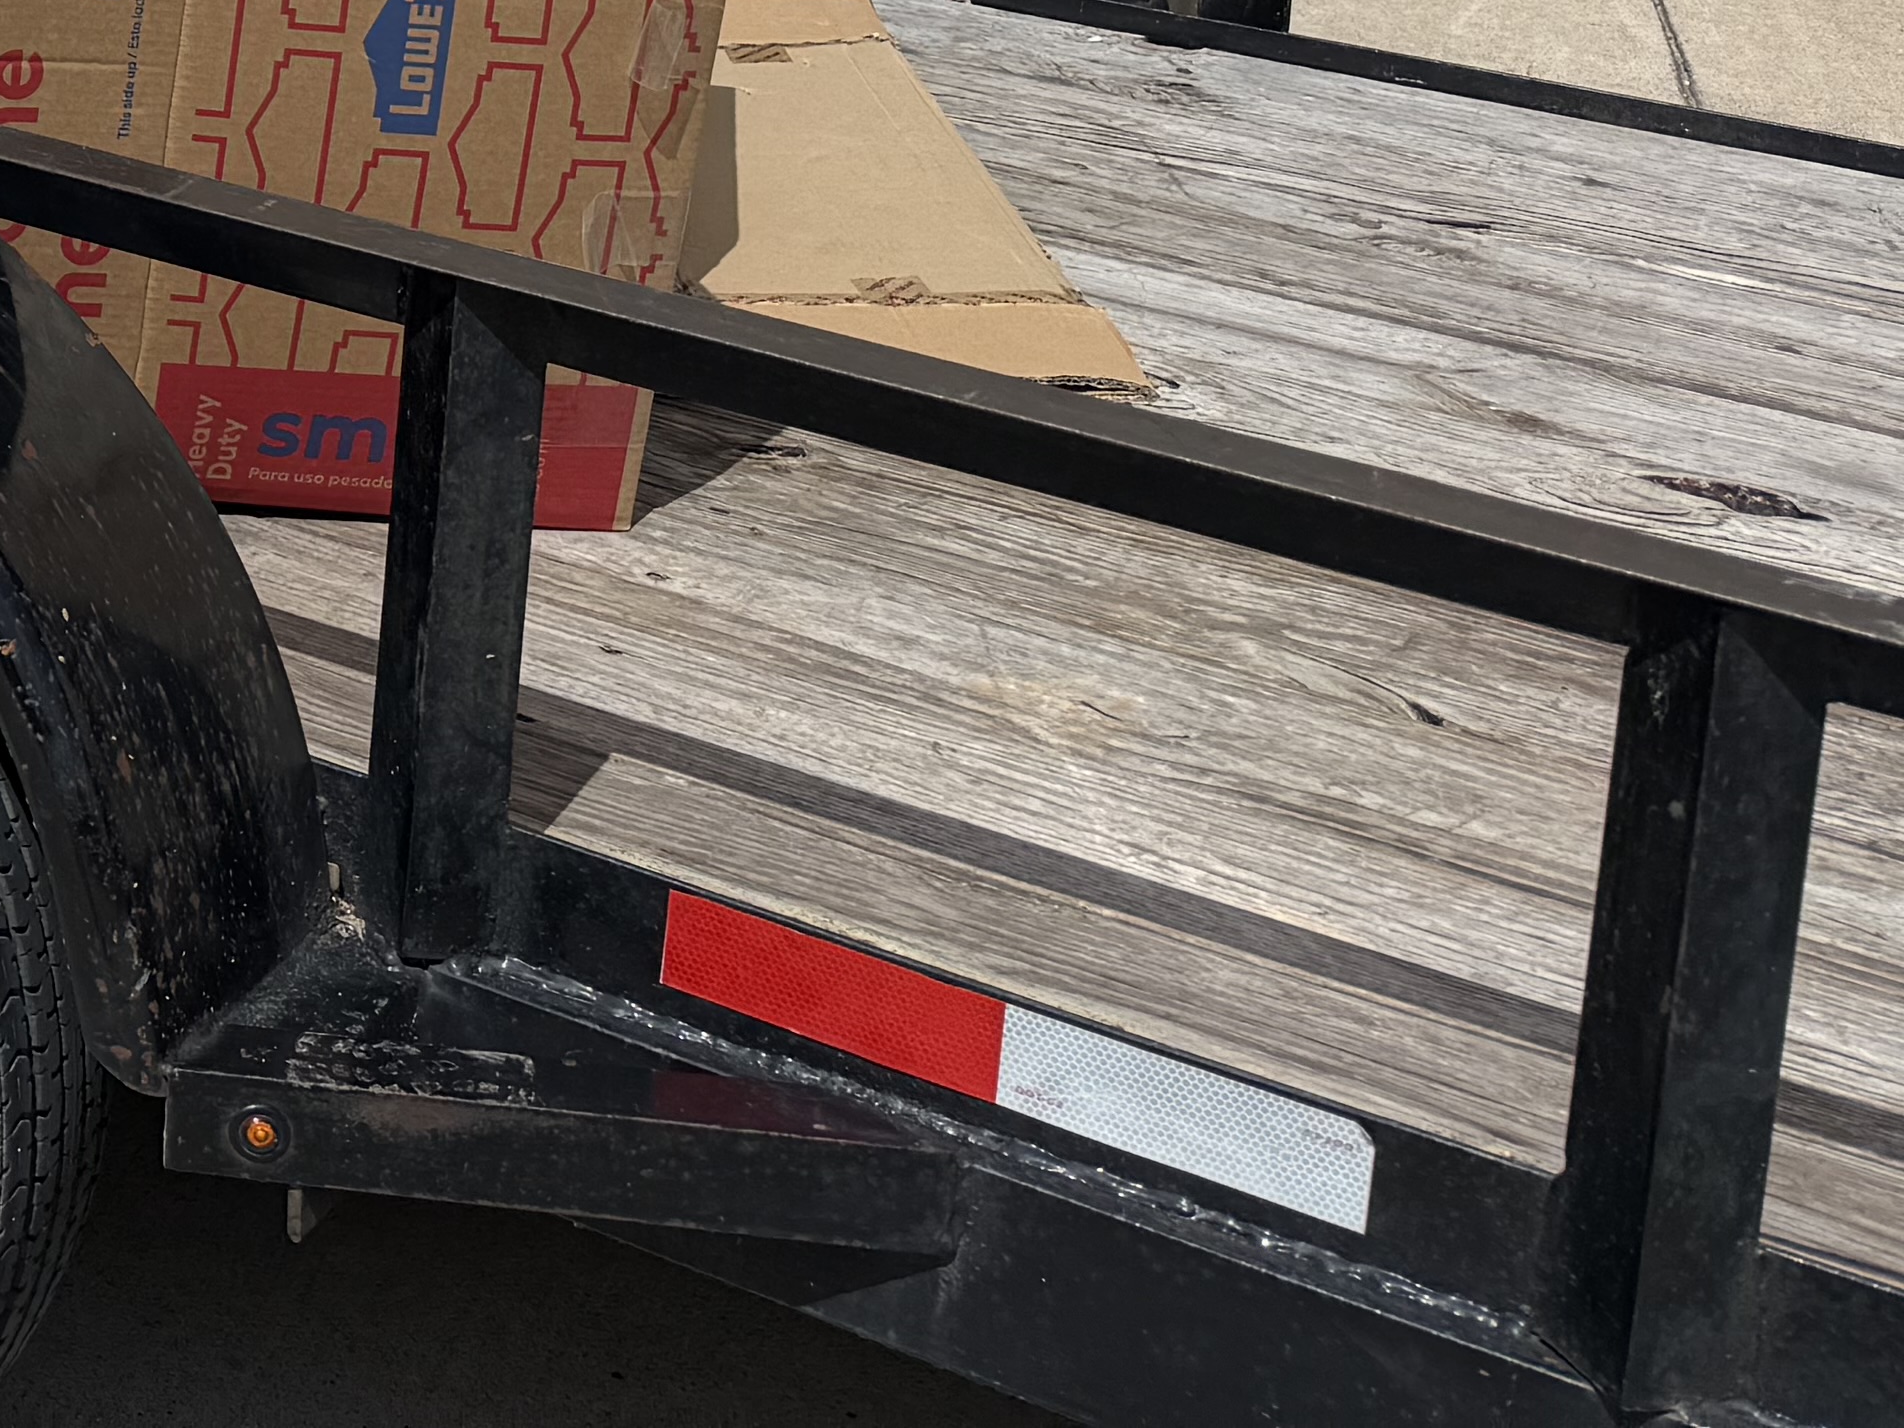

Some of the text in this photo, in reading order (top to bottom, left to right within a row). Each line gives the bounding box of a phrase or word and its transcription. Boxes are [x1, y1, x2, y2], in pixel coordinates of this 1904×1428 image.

[127, 62, 140, 81] up
[123, 83, 135, 111] side
[117, 112, 131, 140] This
[206, 418, 248, 480] Duty
[248, 467, 393, 490] Para uso pesado
